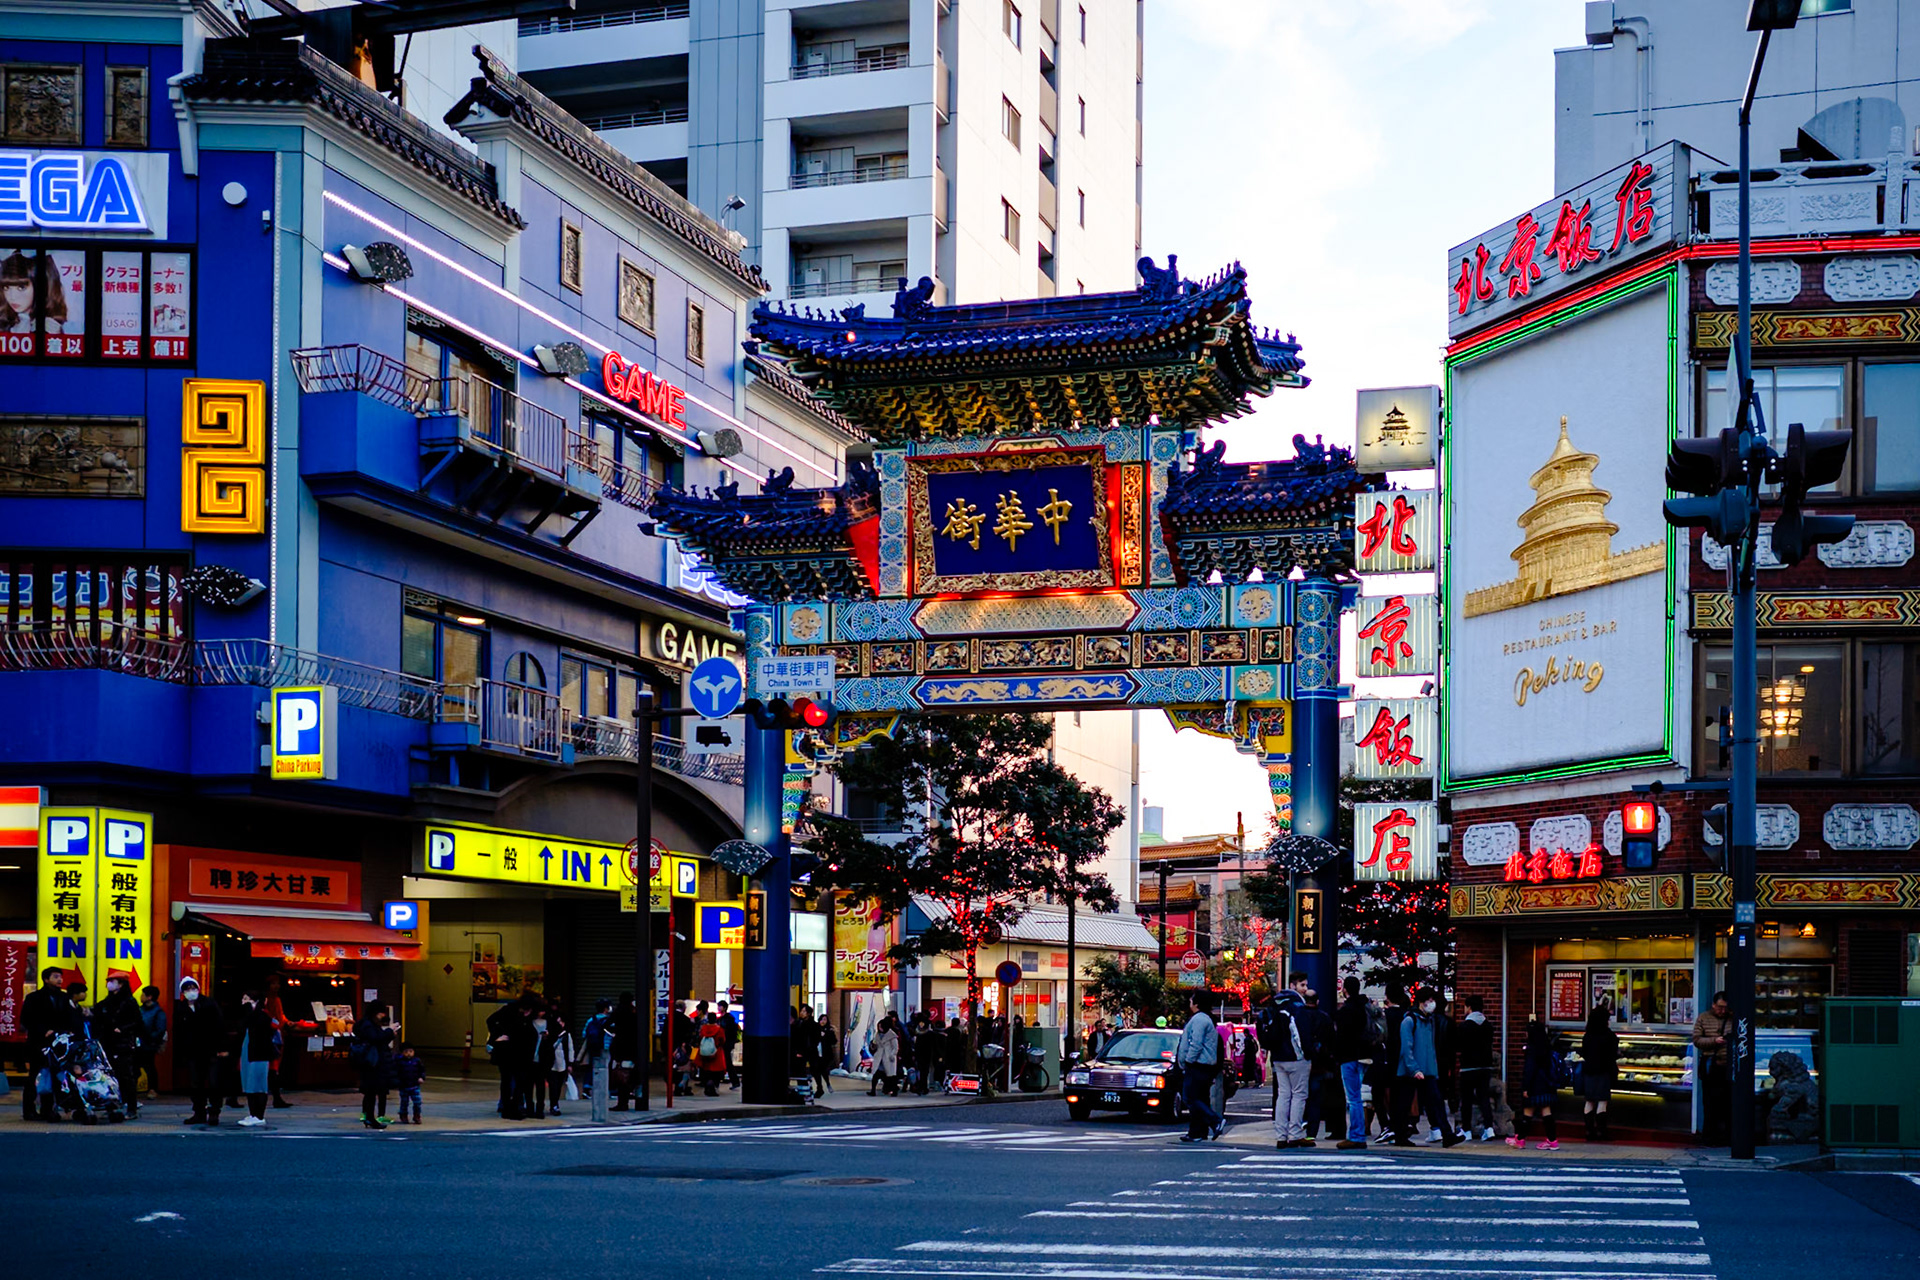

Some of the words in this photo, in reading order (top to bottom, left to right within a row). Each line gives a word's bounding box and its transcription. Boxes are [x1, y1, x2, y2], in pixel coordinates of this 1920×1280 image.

[1454, 161, 1653, 314] 北京飯店
[106, 319, 138, 328] USAGI
[602, 350, 686, 431] GAME
[1503, 629, 1578, 656] RESTAURANT
[1581, 627, 1588, 640] &
[1593, 620, 1618, 637] BAR
[1539, 611, 1586, 631] CHINESE
[762, 660, 829, 677] 中華街東門
[768, 678, 790, 688] China
[793, 677, 814, 687] Town
[1514, 655, 1605, 706] Peking
[281, 697, 318, 752] P
[276, 760, 294, 773] China
[296, 760, 321, 773] Parking
[50, 819, 88, 853] P
[108, 821, 144, 856] P
[431, 832, 454, 869] P
[477, 845, 518, 872] 一般
[562, 849, 592, 883] IN
[678, 864, 696, 893] P
[1504, 843, 1603, 884] 北京飯店
[53, 860, 82, 932] 一般有料
[111, 862, 138, 934] 一般有料
[210, 867, 331, 896] 聘珍大甘栗
[391, 905, 412, 926] P
[1302, 895, 1315, 945] 朝陽門
[47, 936, 87, 958] IN
[105, 937, 143, 959] IN
[835, 950, 878, 961] チャイナ
